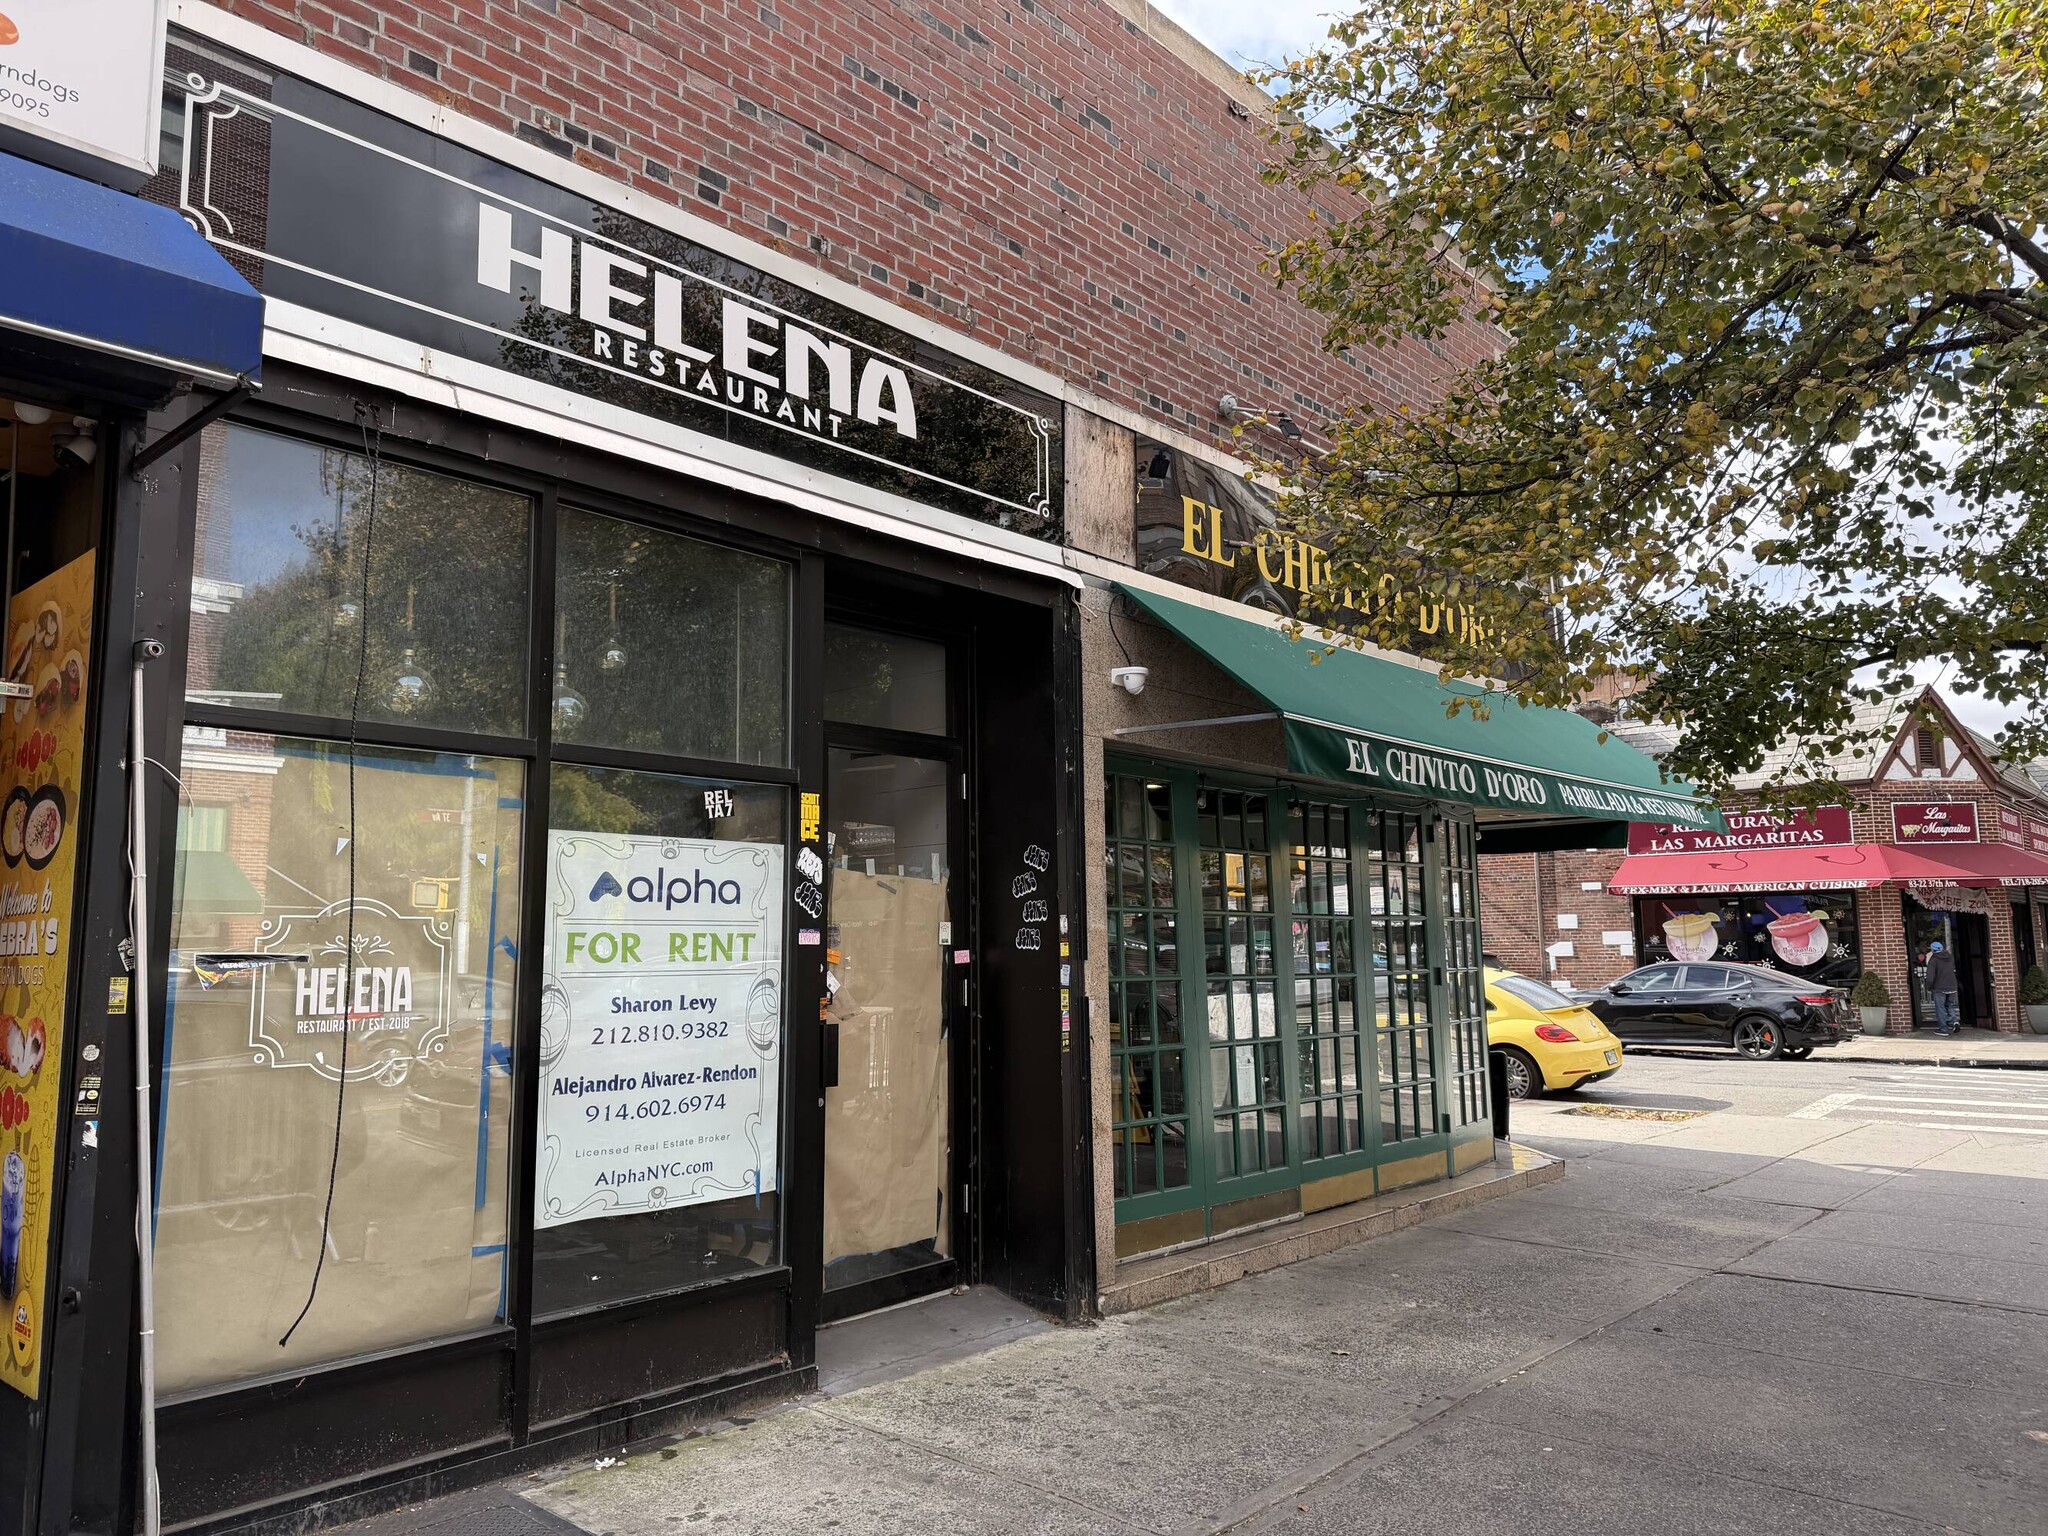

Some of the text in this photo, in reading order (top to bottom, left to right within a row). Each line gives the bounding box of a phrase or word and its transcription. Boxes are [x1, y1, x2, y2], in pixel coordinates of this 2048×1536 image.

[477, 202, 917, 439] HELENA
[594, 329, 842, 438] RESTAURANT
[1180, 495, 1235, 568] EL
[1345, 737, 1546, 805] EL CHIVITO D'ORO
[704, 789, 733, 805] REL
[1557, 782, 1636, 814] PARRILLADA
[1640, 797, 1711, 825] RESTAURANTE
[705, 802, 733, 819] TA7
[1923, 806, 1947, 820] Las
[1651, 829, 1825, 852] LAS MARGARITAS
[1921, 821, 1971, 838] Margaritas
[41, 877, 53, 914] to
[627, 867, 741, 911] alpha
[1621, 886, 1677, 895] TEX-MEX
[1692, 883, 1730, 893] LATIN
[1733, 880, 1806, 892] AMERICAN
[1809, 879, 1868, 890] CUISINE
[1928, 879, 1944, 888] 37th
[1945, 879, 1960, 888] Ave.
[565, 932, 757, 964] FOR RENT
[18, 965, 44, 986] DOGS
[295, 966, 412, 1016] HELENA
[611, 994, 718, 1014] Sharon Levy
[297, 1018, 356, 1034] RESTAURANT
[389, 1016, 410, 1030] 2018
[591, 1021, 729, 1045] 212.810.9382
[552, 1064, 757, 1098] Alejandro Alvarez-Rendon
[585, 1093, 727, 1123] 914.602.6974
[575, 1133, 731, 1158] Licensed Real Estate Broker
[594, 1160, 714, 1187] AlphaNYC.com
